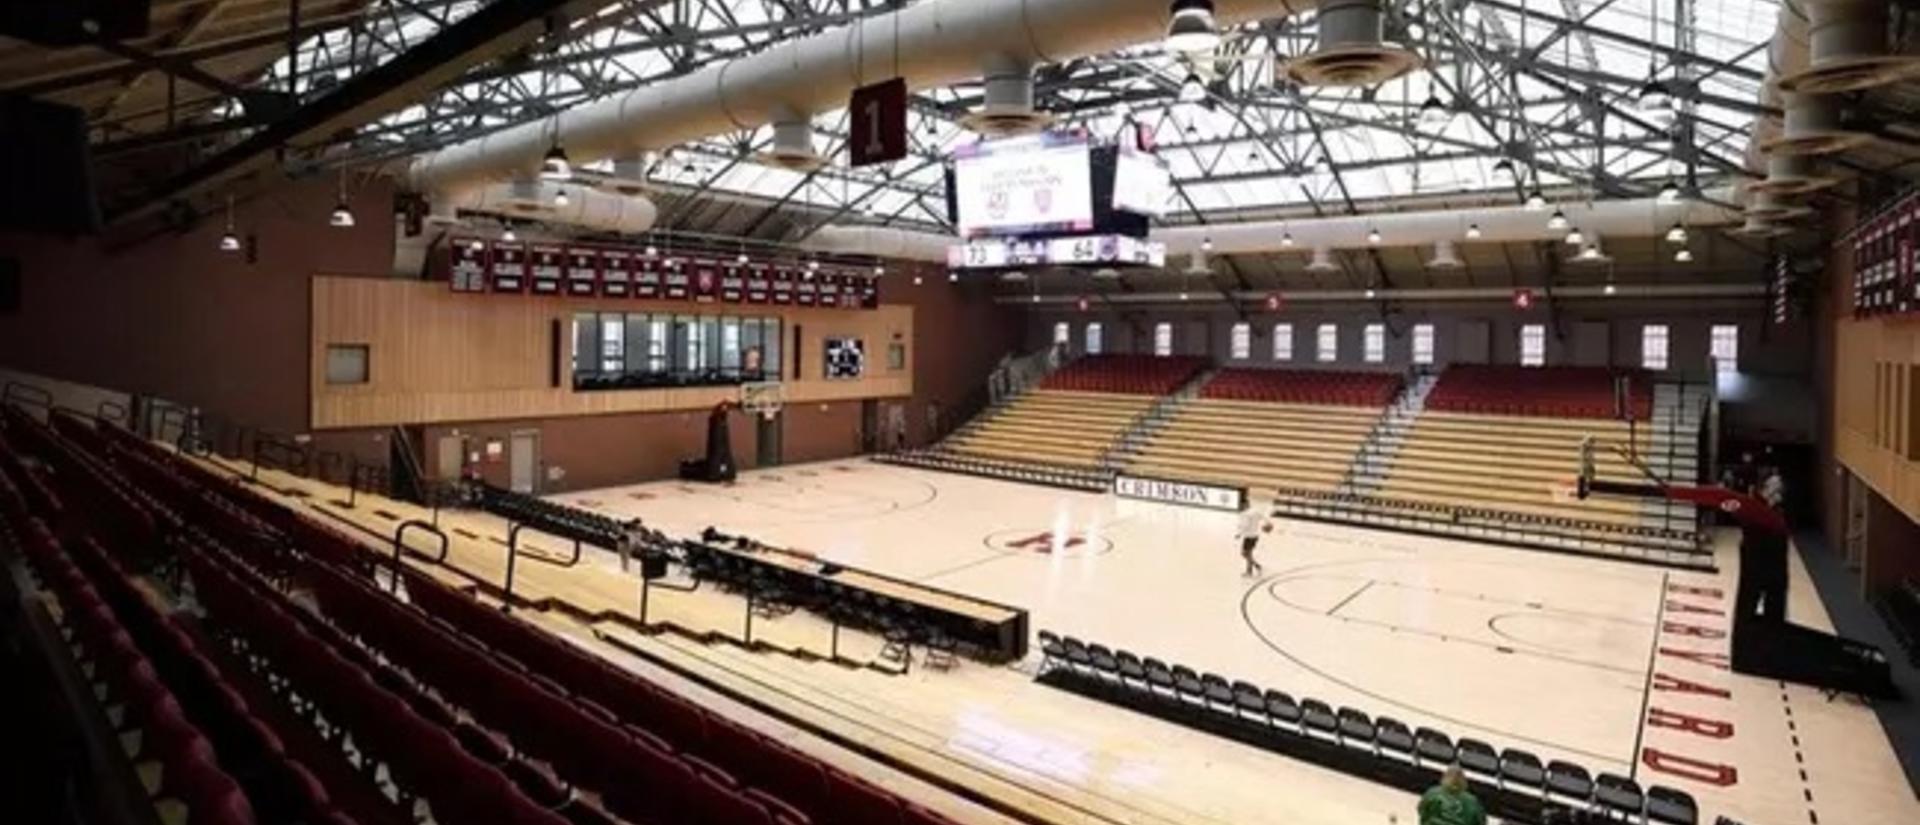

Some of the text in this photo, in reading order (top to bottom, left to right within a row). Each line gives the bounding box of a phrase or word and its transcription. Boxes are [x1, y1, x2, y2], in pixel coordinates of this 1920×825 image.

[864, 100, 884, 155] 1
[1072, 239, 1094, 259] 64
[1121, 480, 1209, 505] CRIMSON
[1642, 583, 1738, 787] HARVARD
